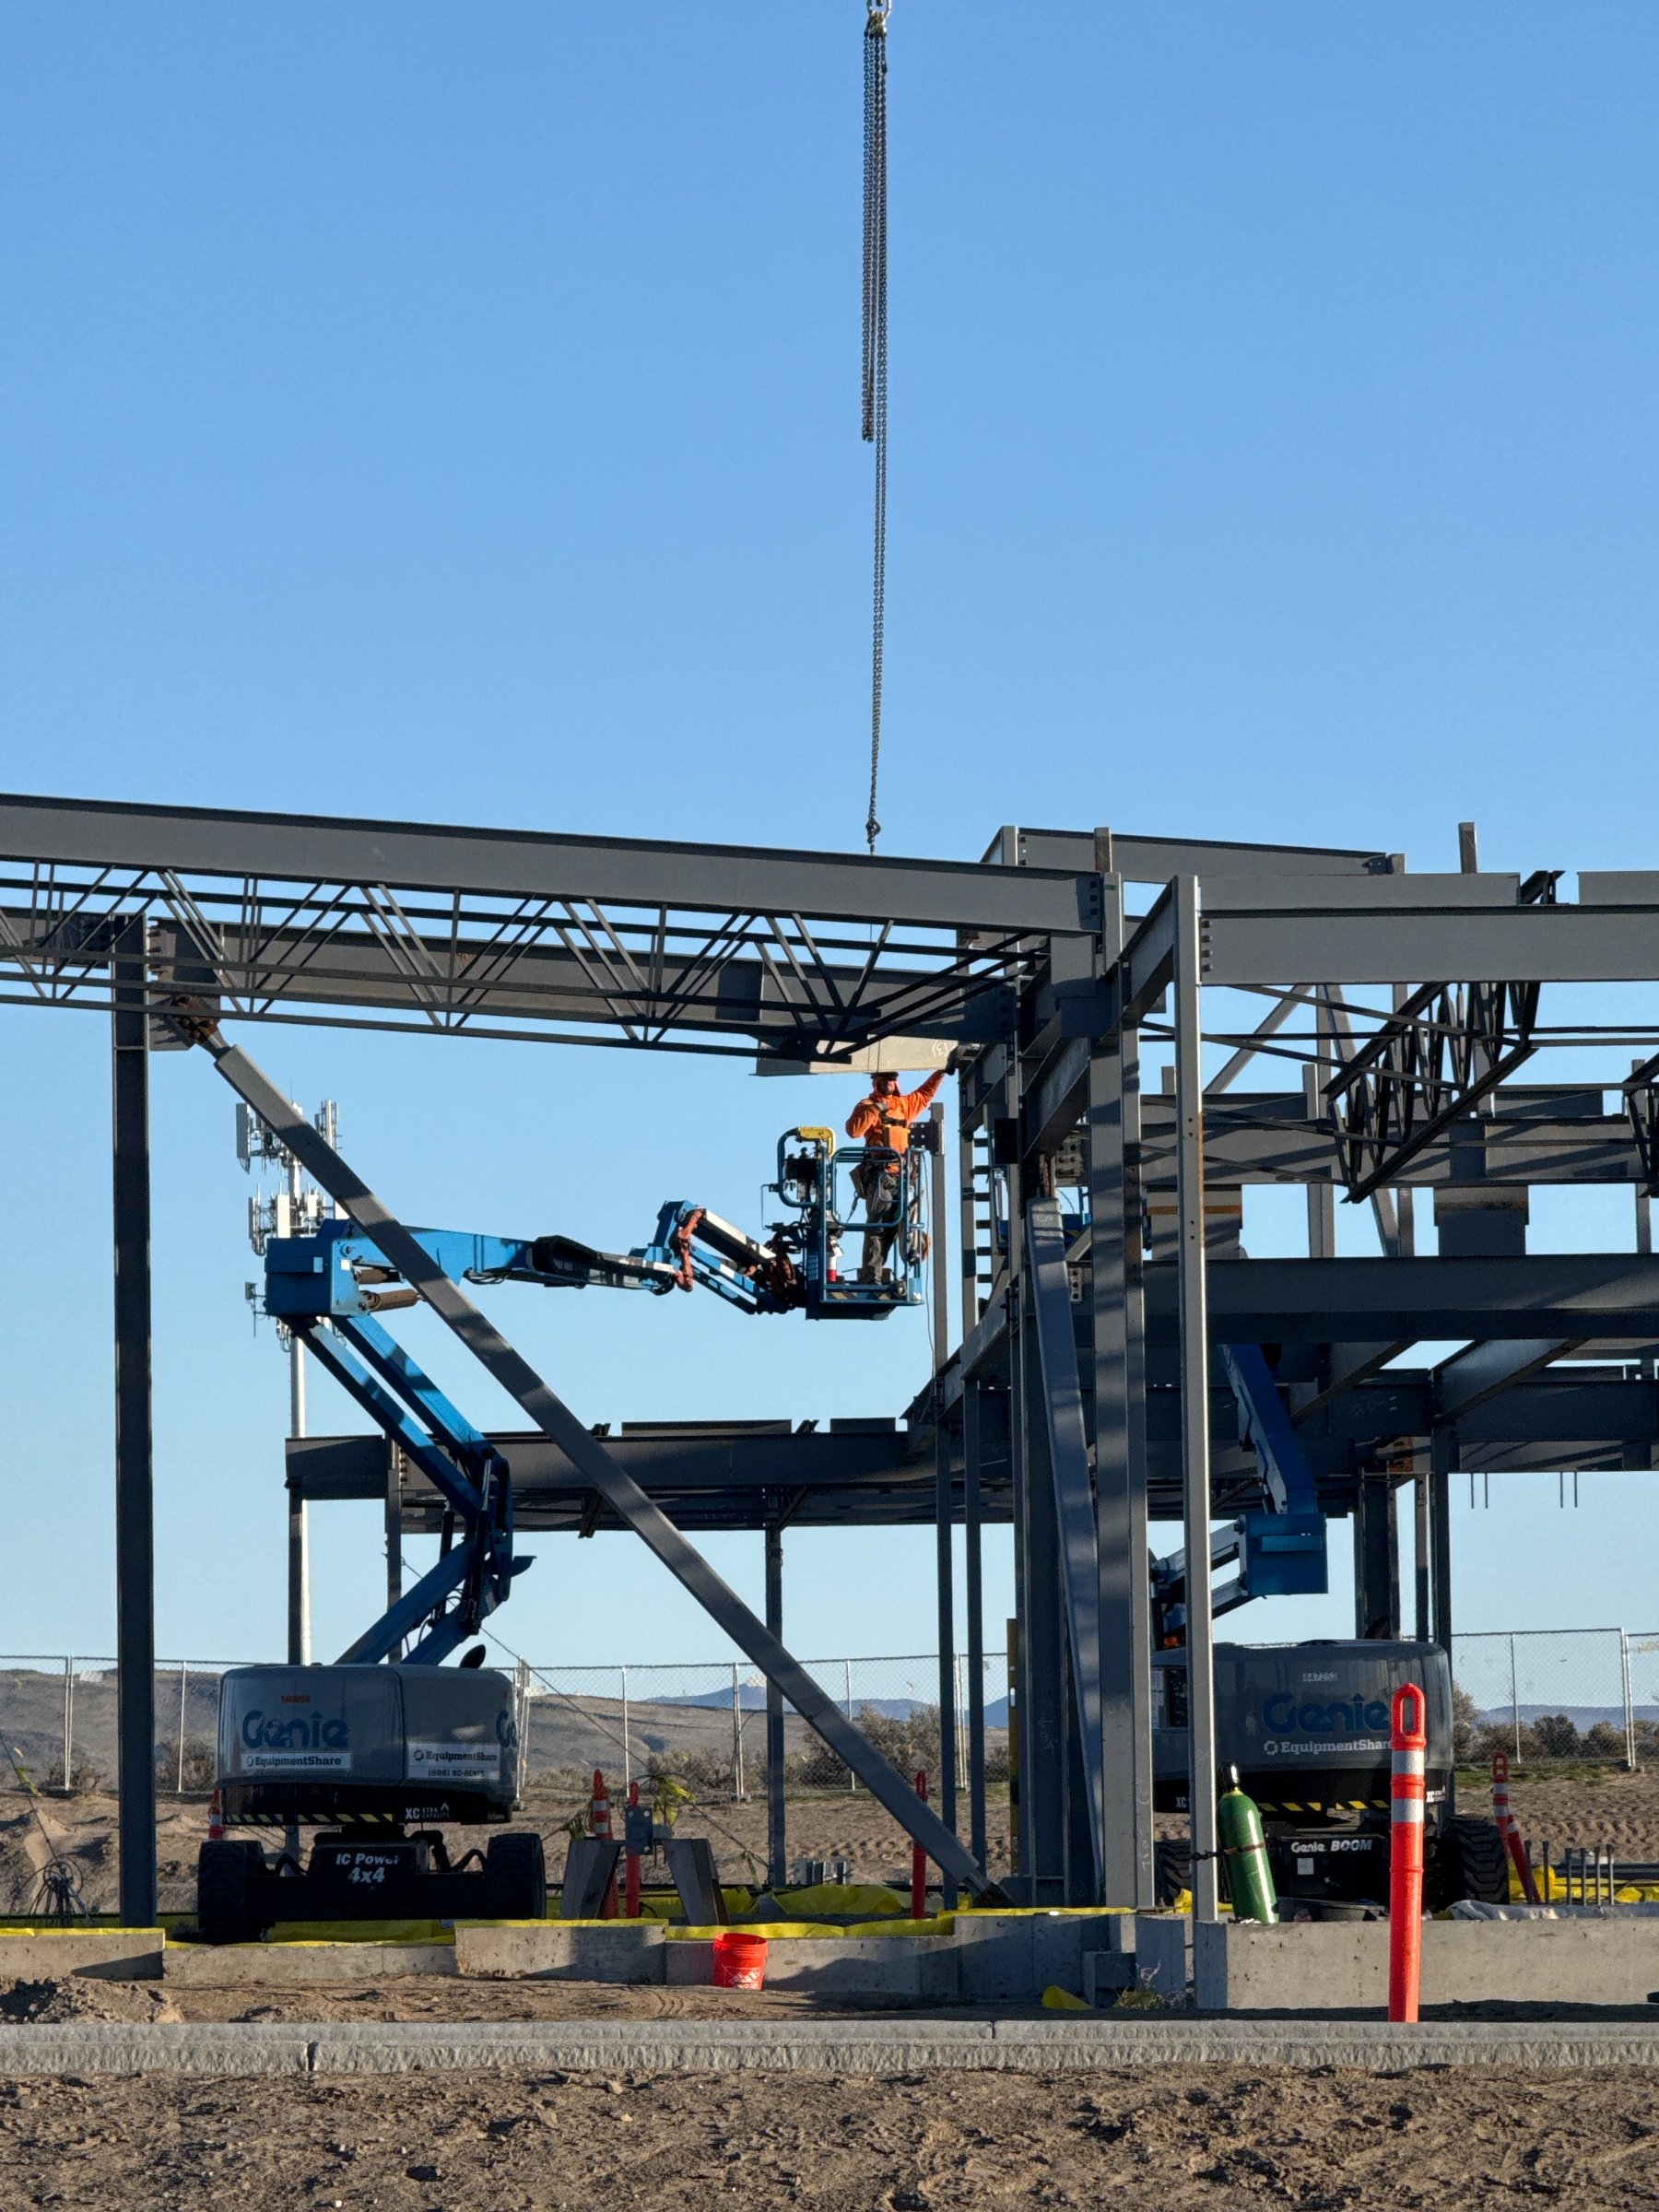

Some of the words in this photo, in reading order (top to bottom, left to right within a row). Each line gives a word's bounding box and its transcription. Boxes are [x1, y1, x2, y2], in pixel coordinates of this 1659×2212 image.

[1262, 1690, 1390, 1735] Genie
[242, 1710, 350, 1749] Genie
[1280, 1738, 1393, 1755] EquipmentShare
[254, 1756, 342, 1767] EquipmentShare
[426, 1751, 498, 1762] EquipmentShare
[1175, 1796, 1187, 1808] XC
[405, 1807, 420, 1819] XC
[1291, 1841, 1325, 1853] Genie
[1330, 1840, 1372, 1852] BOOM
[335, 1853, 351, 1865] IC
[348, 1866, 385, 1884] 4x4
